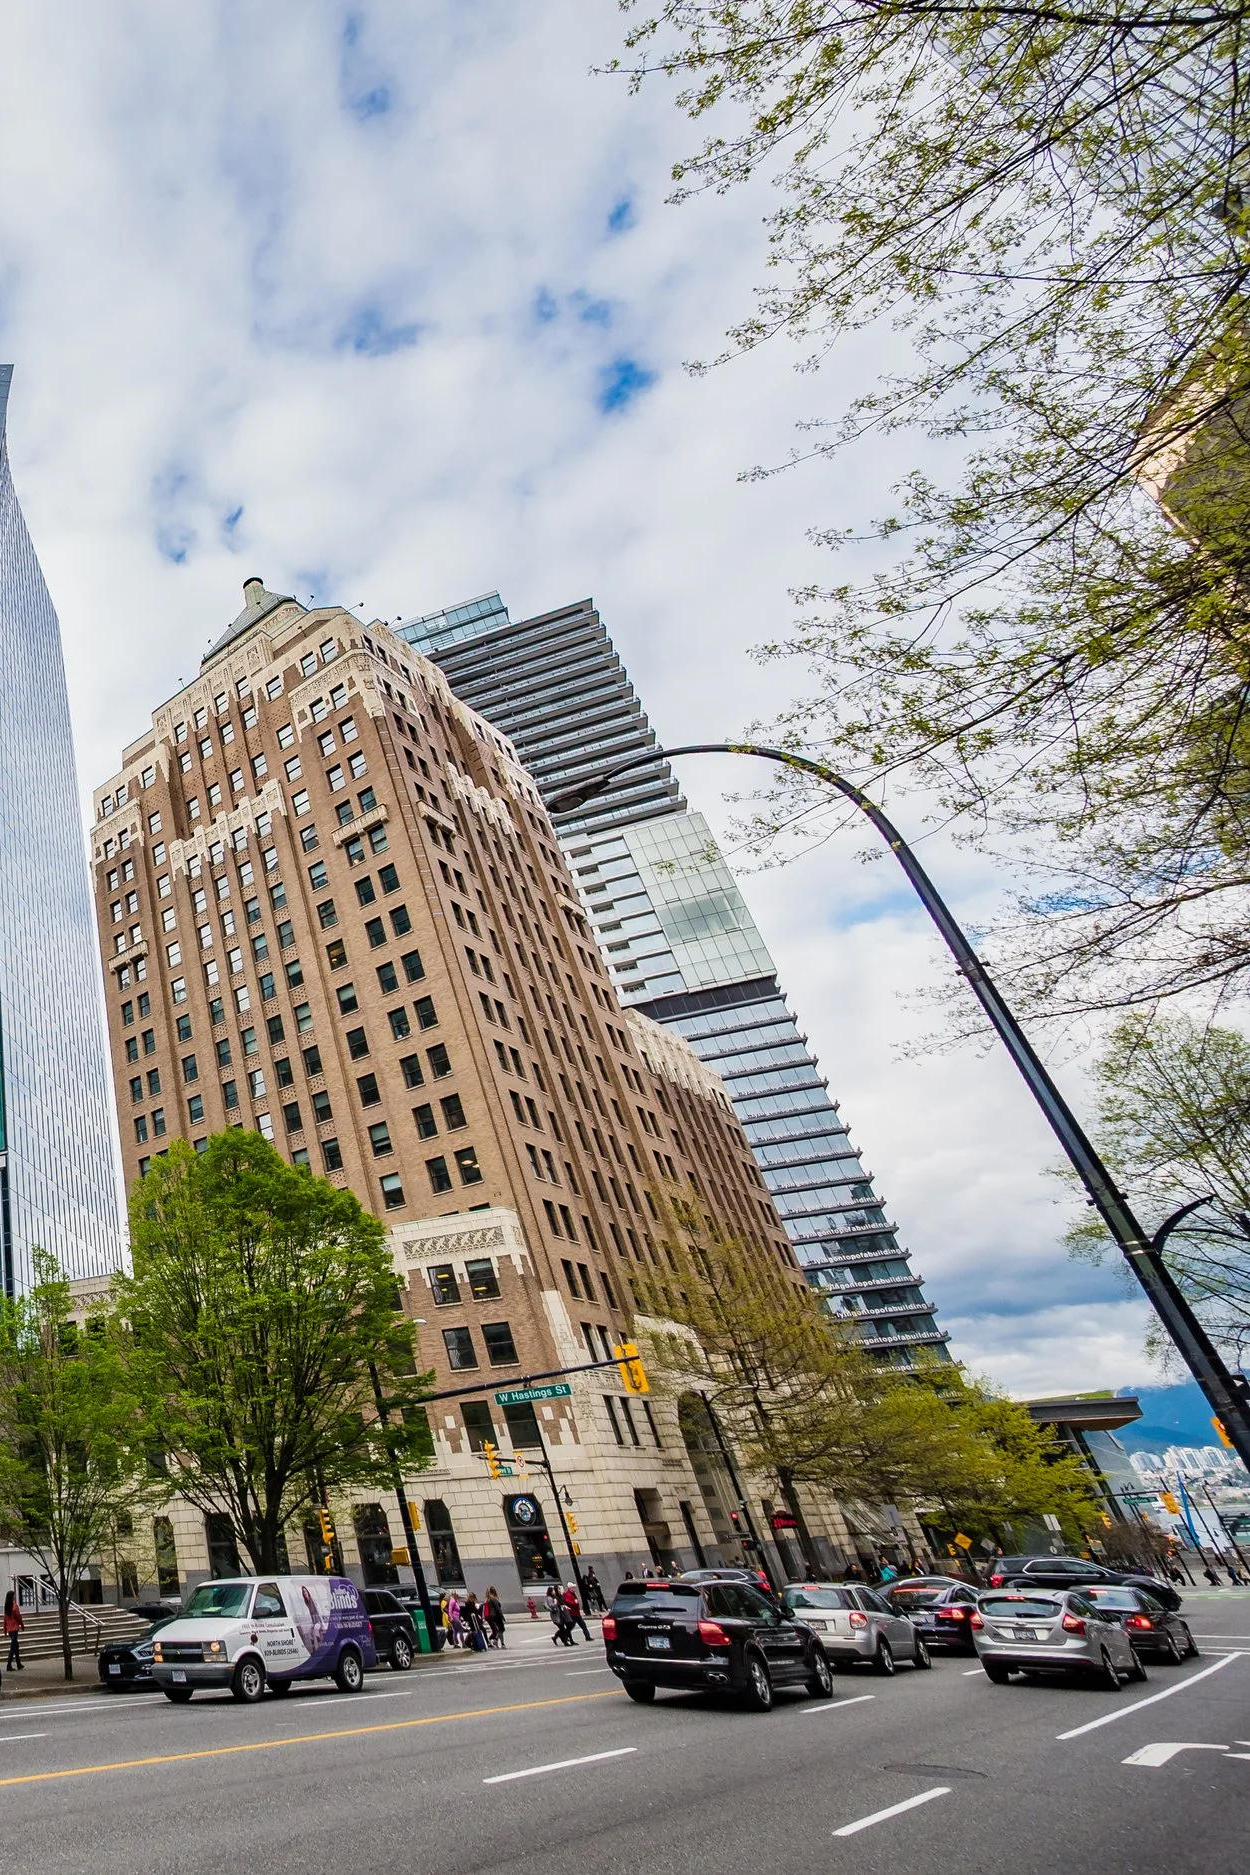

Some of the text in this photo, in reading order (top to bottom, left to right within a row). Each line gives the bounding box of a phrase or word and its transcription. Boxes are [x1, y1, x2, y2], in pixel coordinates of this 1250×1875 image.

[499, 1385, 567, 1402] W Hastings St
